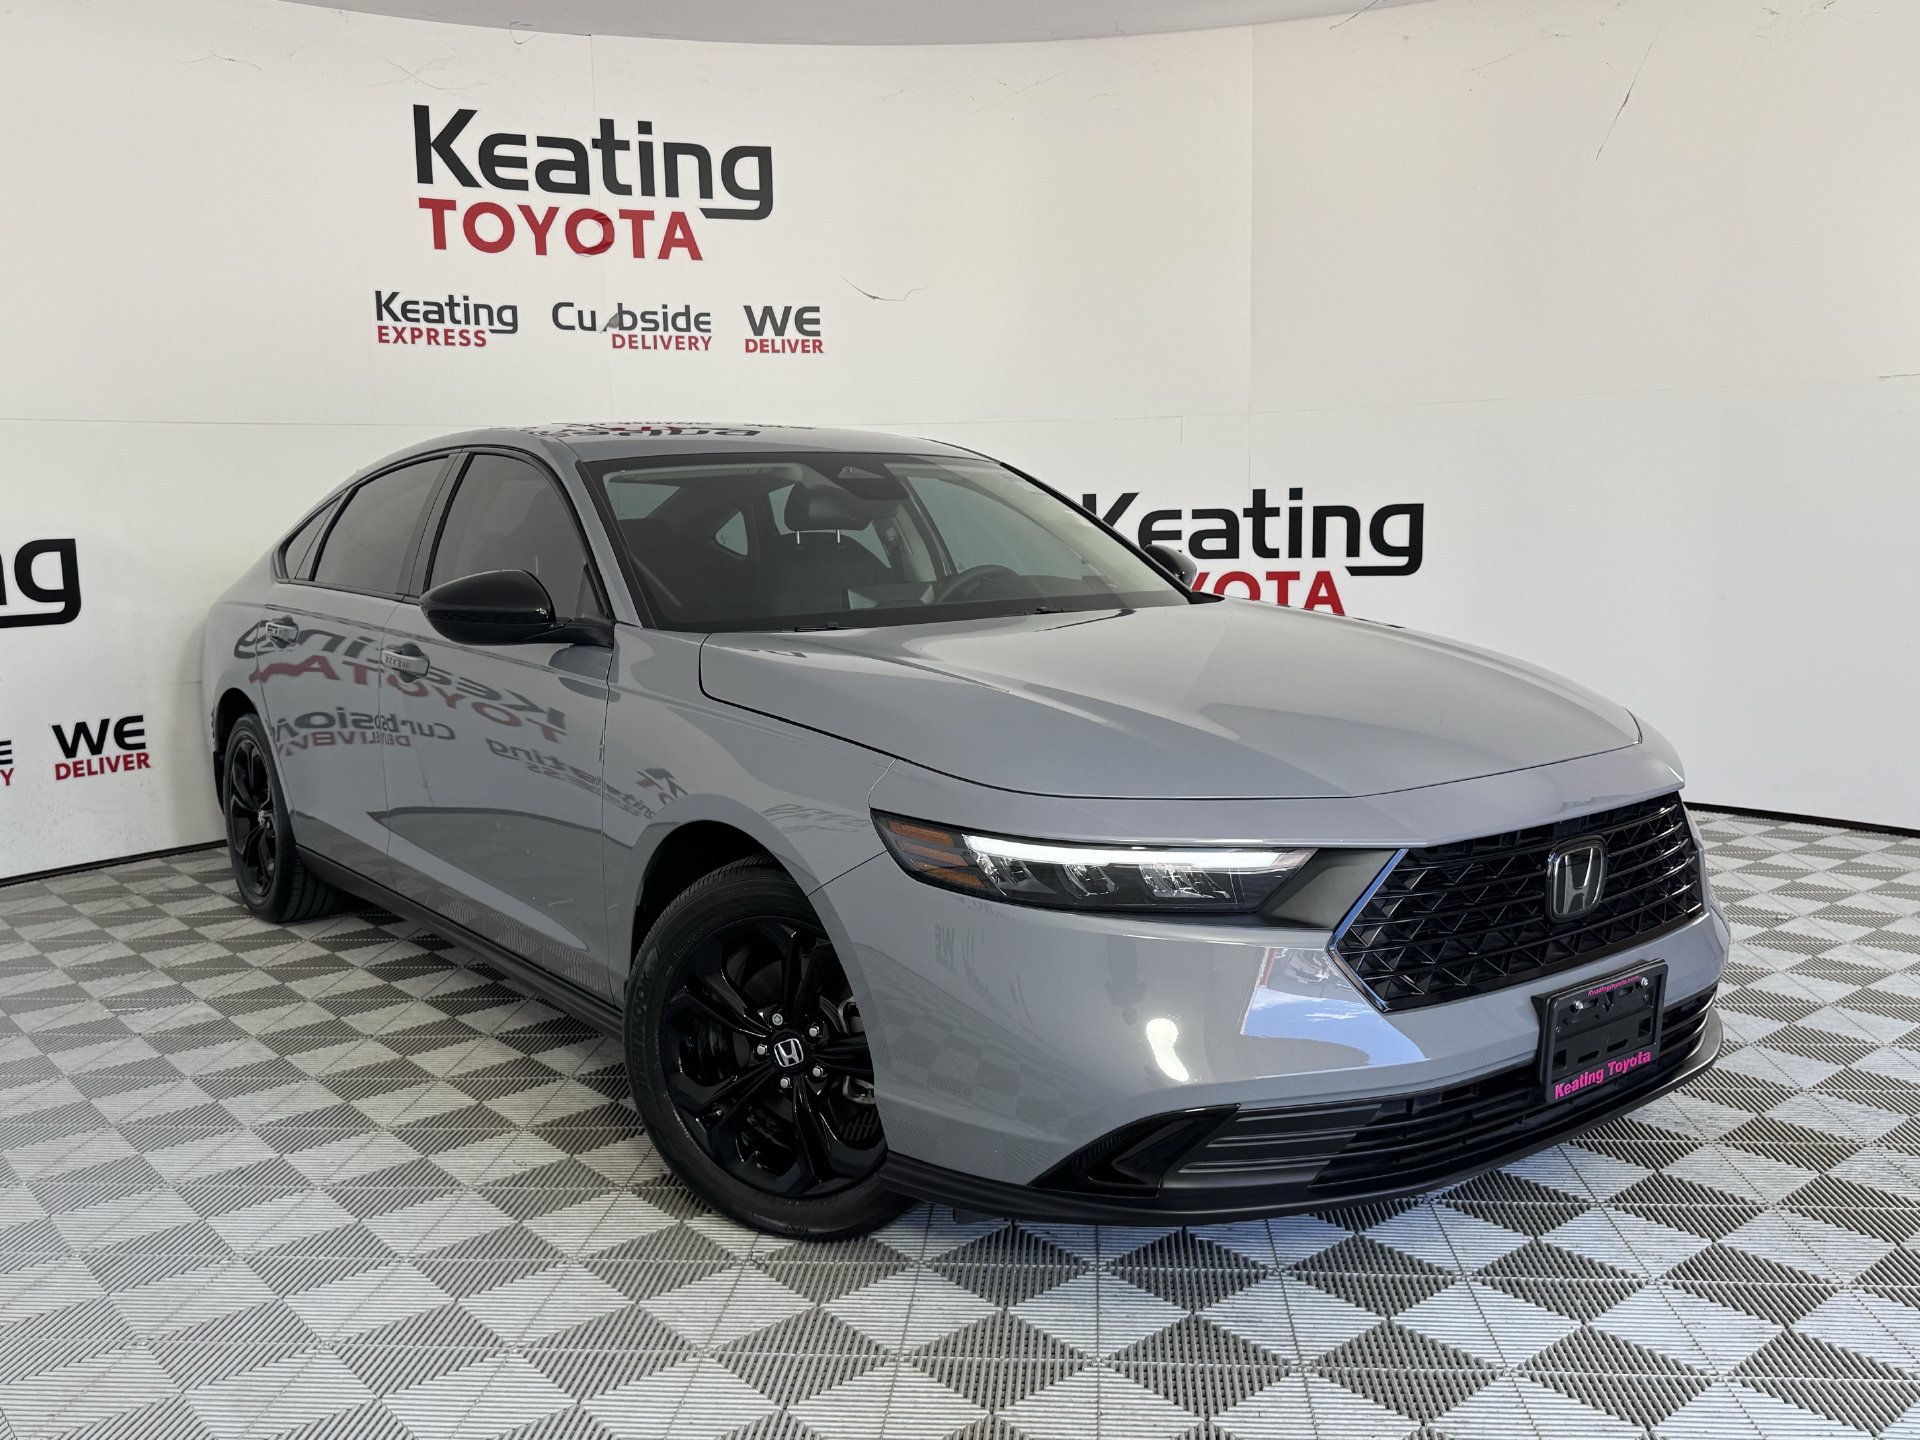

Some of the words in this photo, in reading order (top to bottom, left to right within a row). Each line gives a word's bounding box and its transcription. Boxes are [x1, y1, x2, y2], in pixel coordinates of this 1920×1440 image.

[413, 104, 774, 220] Keating
[418, 197, 703, 261] TOYOTA
[375, 290, 518, 334] Keating
[552, 301, 712, 333] Cubside
[743, 305, 821, 337] WE
[377, 325, 487, 347] EXPRESS
[611, 333, 712, 351] DELIVERY
[744, 338, 824, 354] DELIVER
[51, 714, 147, 759] WE
[54, 751, 151, 781] DELIVER
[1555, 1068, 1604, 1099] Keating
[1607, 1051, 1651, 1075] Toyota
